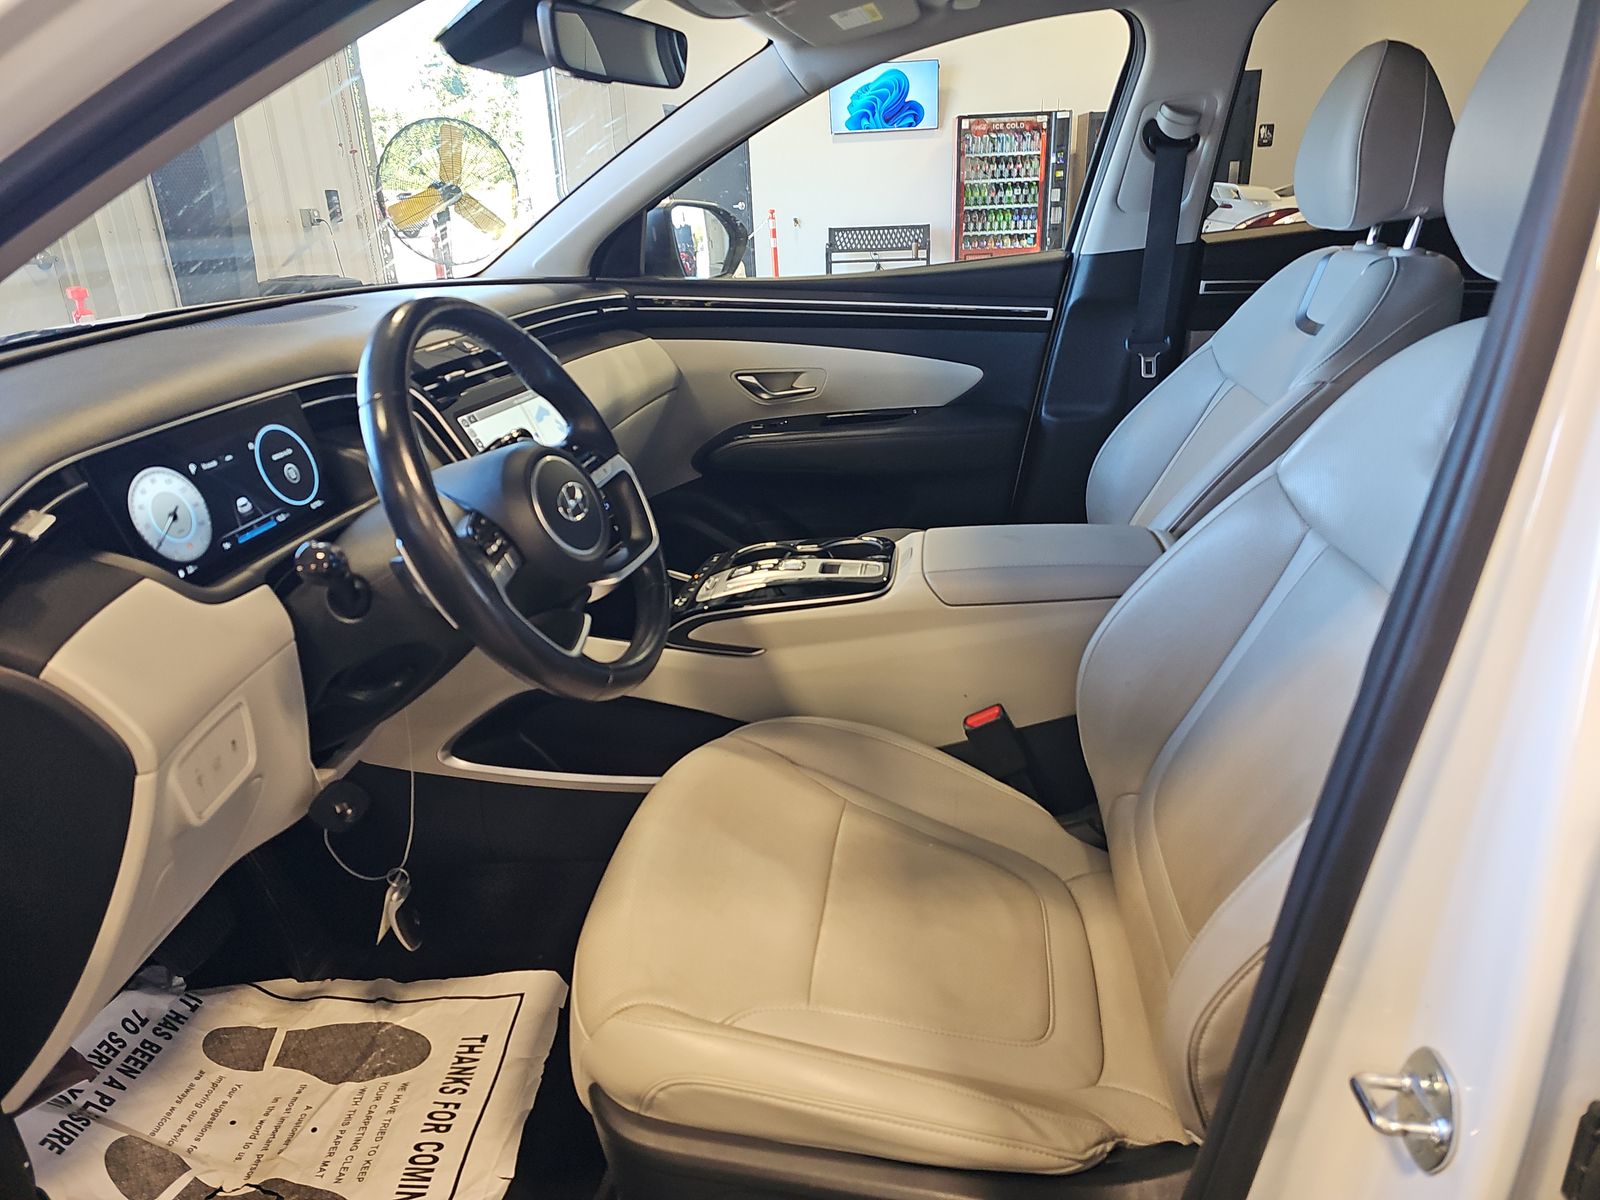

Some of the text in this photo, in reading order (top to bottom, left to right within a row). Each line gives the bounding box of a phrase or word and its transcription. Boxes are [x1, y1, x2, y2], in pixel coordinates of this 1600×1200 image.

[992, 122, 1004, 130] ICE
[1006, 121, 1025, 130] COLD
[121, 1008, 150, 1035] TO
[39, 992, 204, 1156] IT HAS BEEN A PLSURE
[87, 1031, 128, 1083] SERV
[194, 1069, 206, 1081] are
[438, 1034, 489, 1096] THANKS
[175, 1082, 196, 1105] always
[194, 1075, 227, 1109] improving
[228, 1083, 244, 1099] Your
[186, 1110, 198, 1123] our
[194, 1100, 228, 1143] suggestions
[233, 1096, 282, 1163] in the world to us.
[243, 1084, 308, 1181] the most important person
[282, 1113, 308, 1146] customer
[315, 1086, 368, 1179] WITH THIS PAPER MAT
[333, 1081, 390, 1184] YOUR CARPETING CLEAN
[357, 1081, 410, 1183] WE HAVE TRIED TO KEEP
[420, 1101, 462, 1134] FOR
